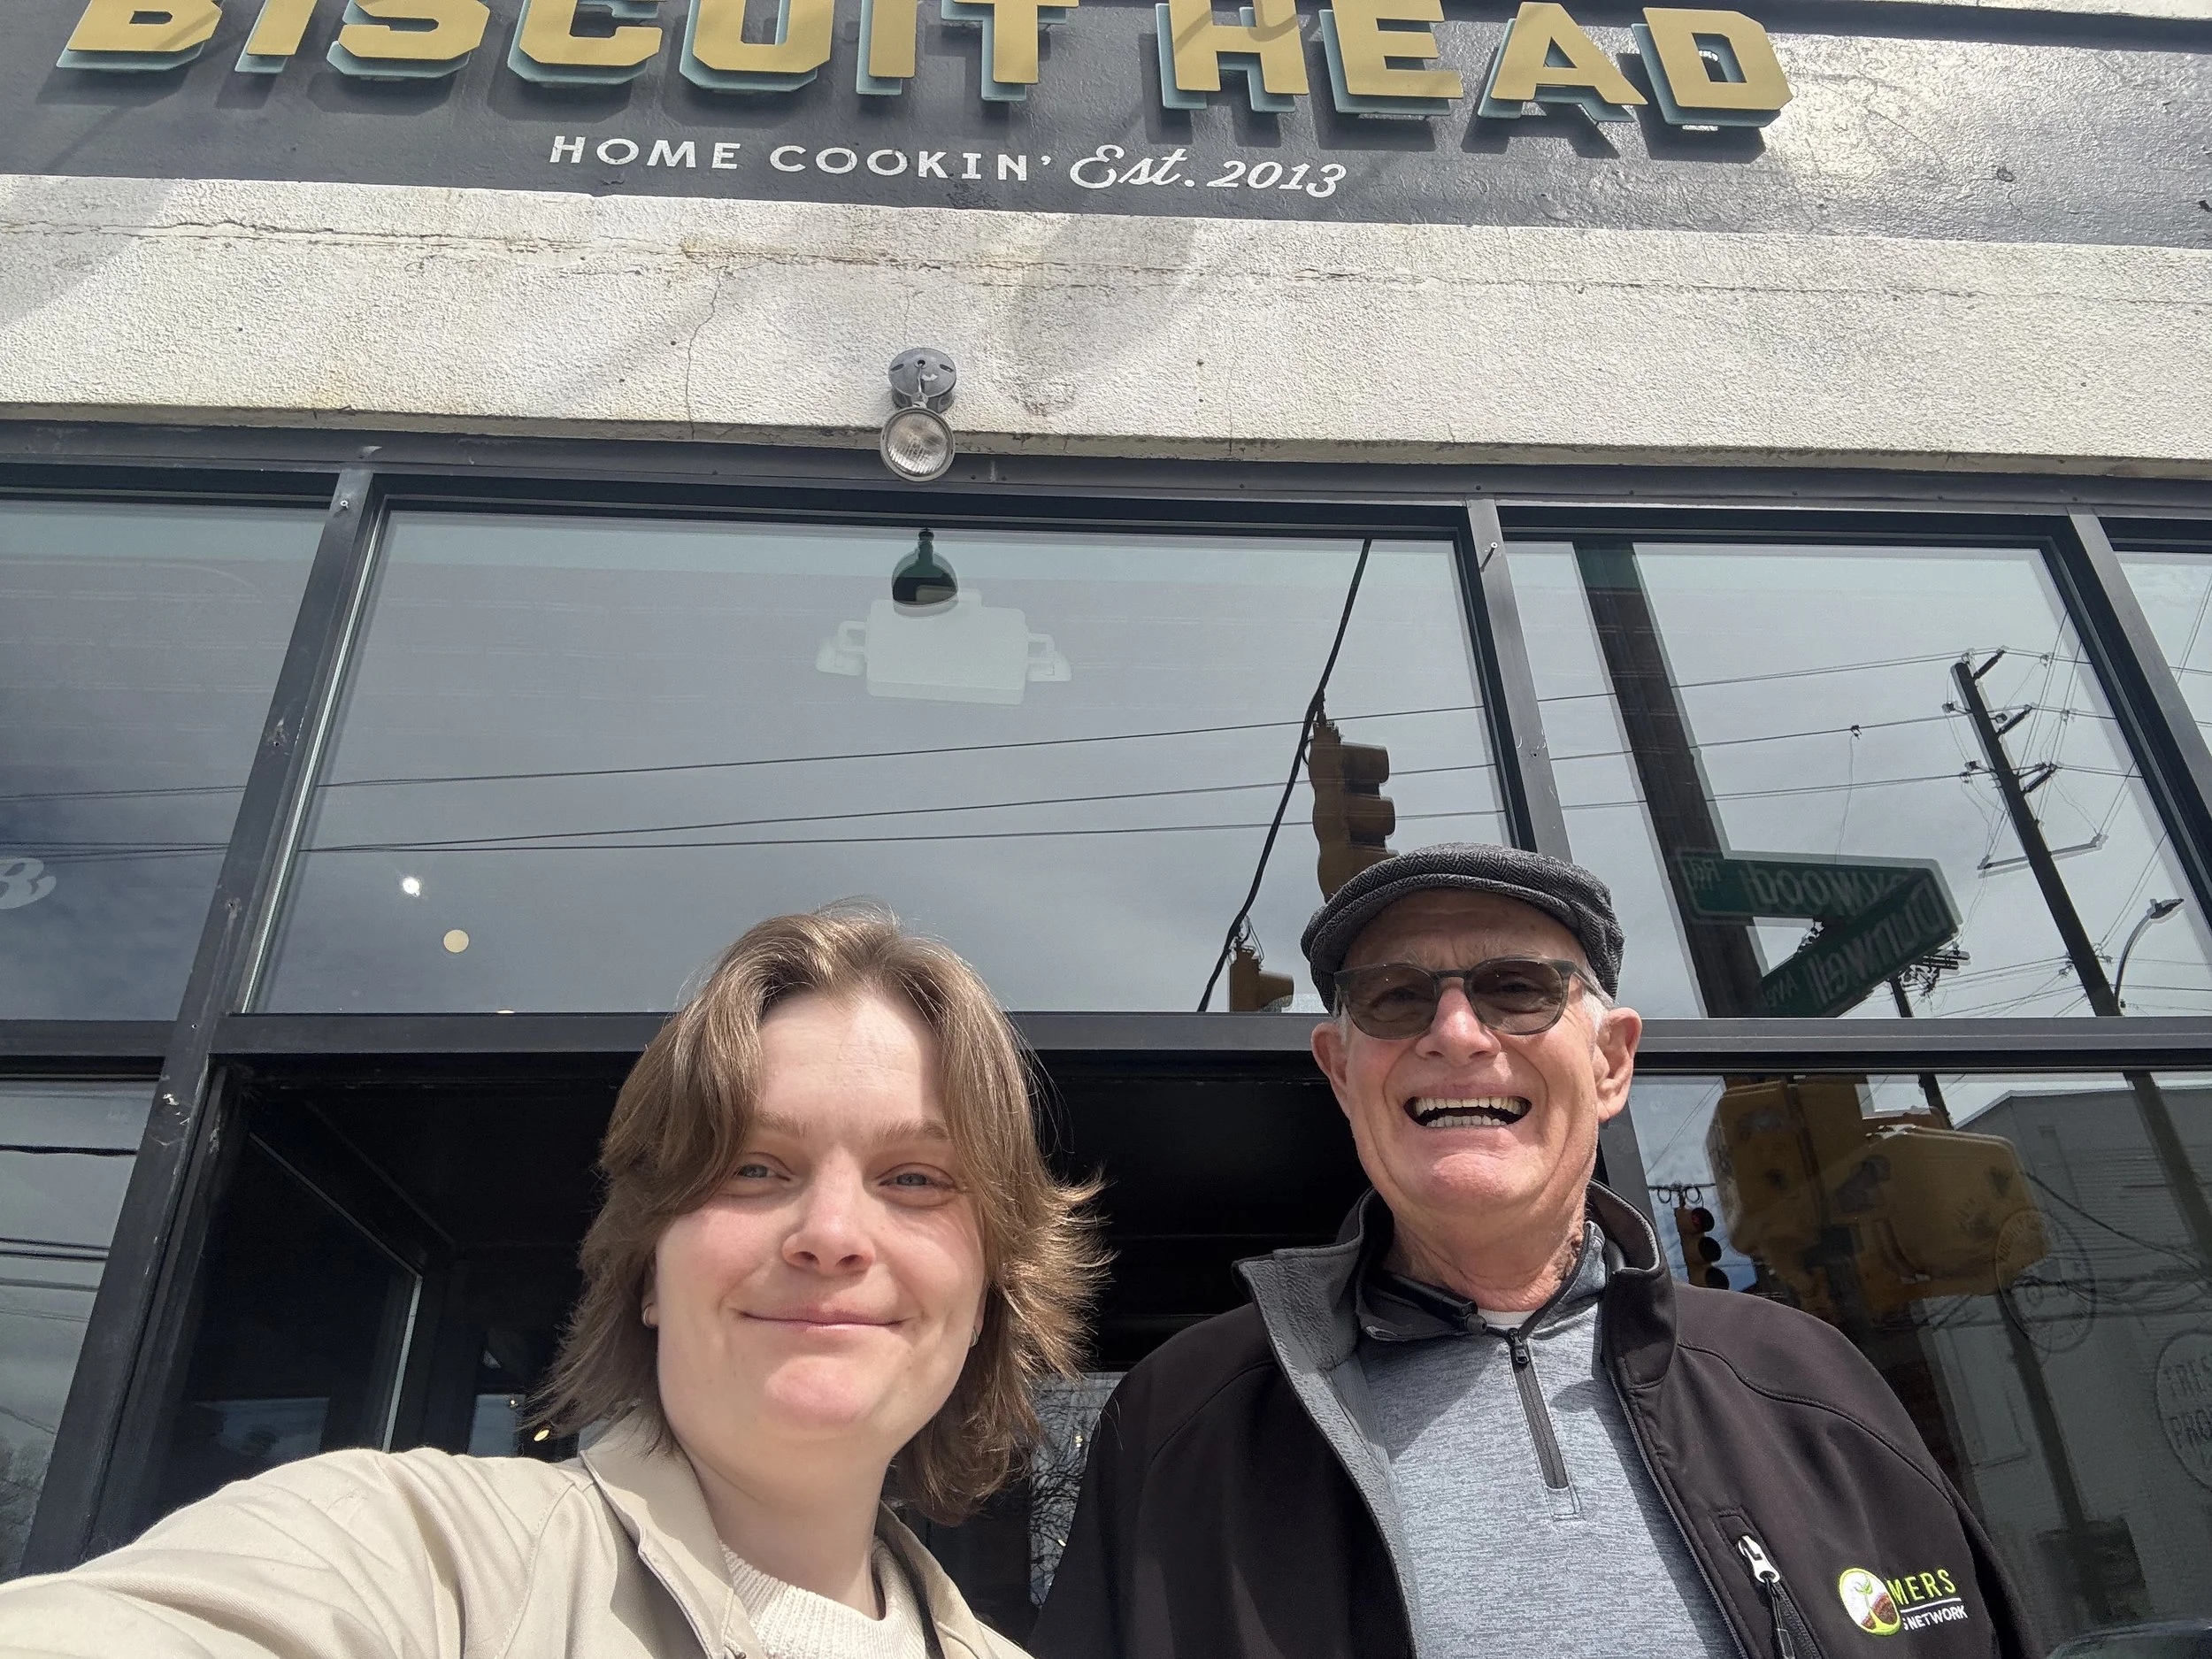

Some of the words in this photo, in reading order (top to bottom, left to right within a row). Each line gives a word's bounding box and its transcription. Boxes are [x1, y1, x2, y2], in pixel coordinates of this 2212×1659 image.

[1161, 0, 1795, 120] HEAD
[549, 134, 741, 172] HOME
[768, 145, 1052, 182] COOKIN'
[1069, 142, 1195, 189] Est.
[1205, 157, 1348, 199] 2013
